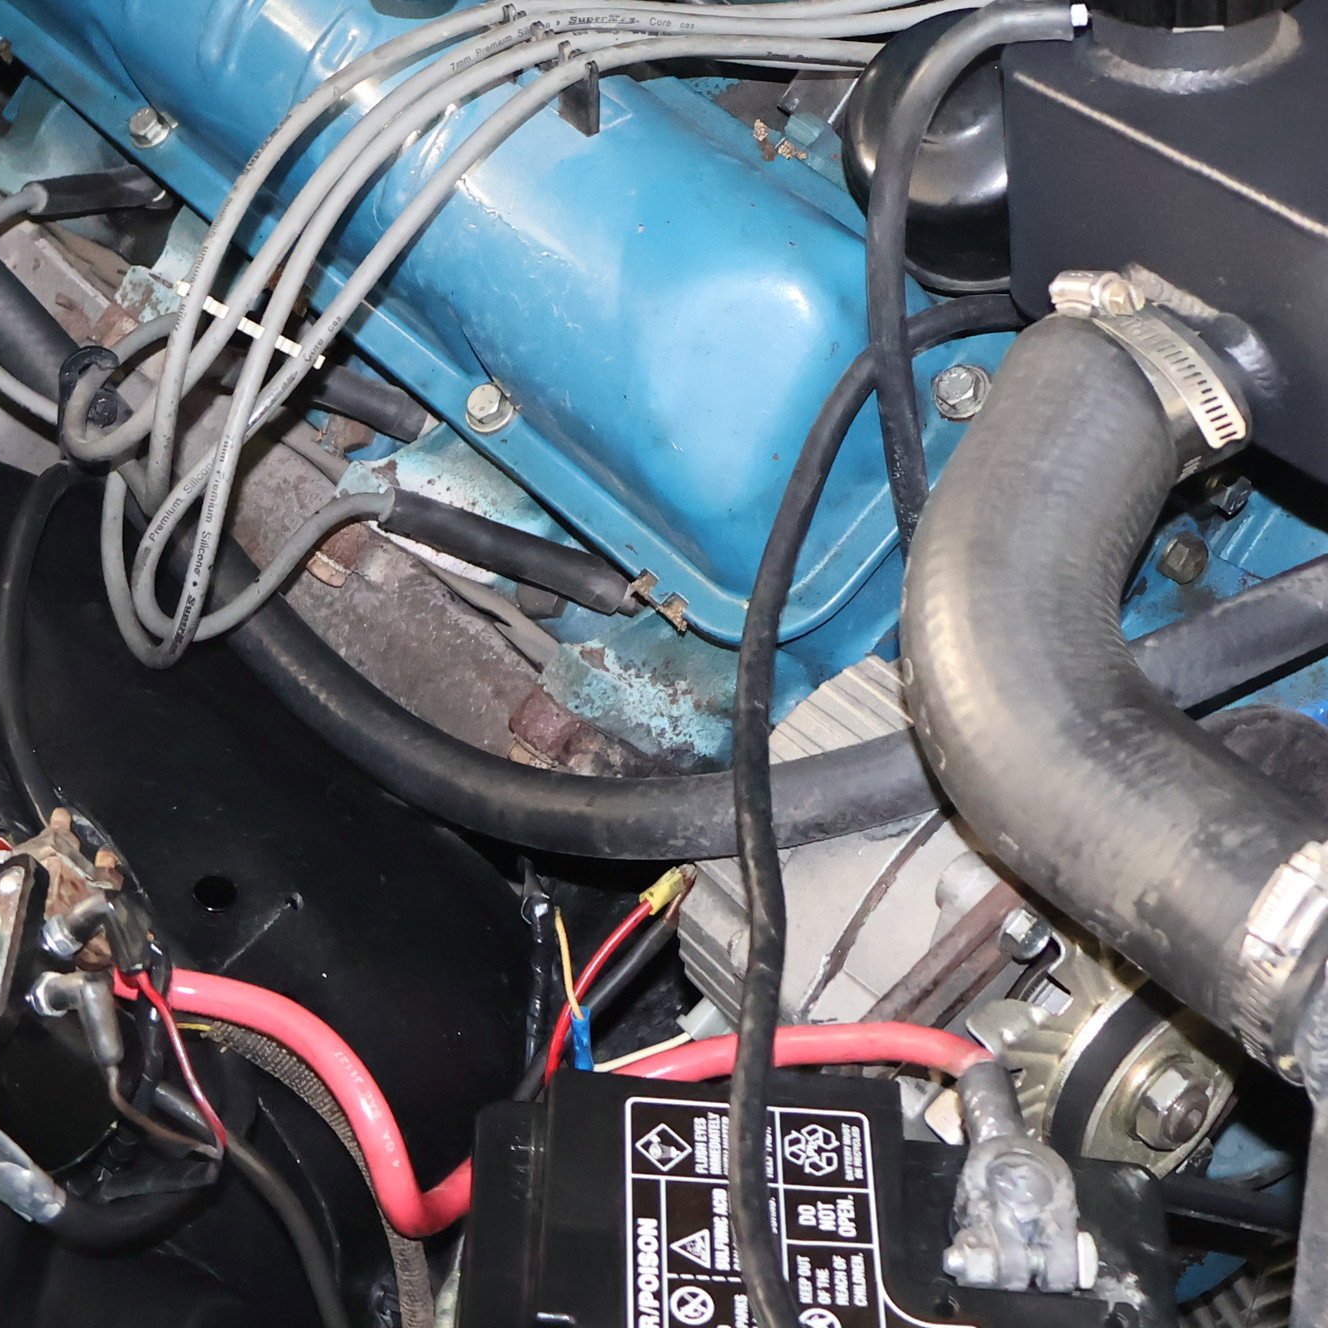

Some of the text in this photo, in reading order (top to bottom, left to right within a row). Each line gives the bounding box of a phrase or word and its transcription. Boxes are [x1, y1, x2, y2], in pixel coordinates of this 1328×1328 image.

[475, 33, 513, 58] Premium
[649, 16, 672, 28] Core
[148, 497, 183, 541] Premium
[693, 1117, 708, 1172] FLUSH EYES
[707, 1111, 721, 1173] IMMEDIATELY
[841, 1122, 853, 1180] BATTERY MUST
[851, 1126, 863, 1179] BE RECYCLED
[712, 1188, 728, 1214] ACID
[798, 1205, 816, 1225] DO
[817, 1201, 835, 1230] NOT
[835, 1194, 857, 1236] OPEN.
[714, 1217, 730, 1270] SULFURIC
[637, 1217, 660, 1328] R/POISON
[797, 1254, 813, 1303] KEEP OUT
[815, 1268, 831, 1304] OF THE
[832, 1255, 849, 1305] REACH OF
[849, 1252, 868, 1306] CHILDREN.
[734, 1294, 748, 1328] PARKS
